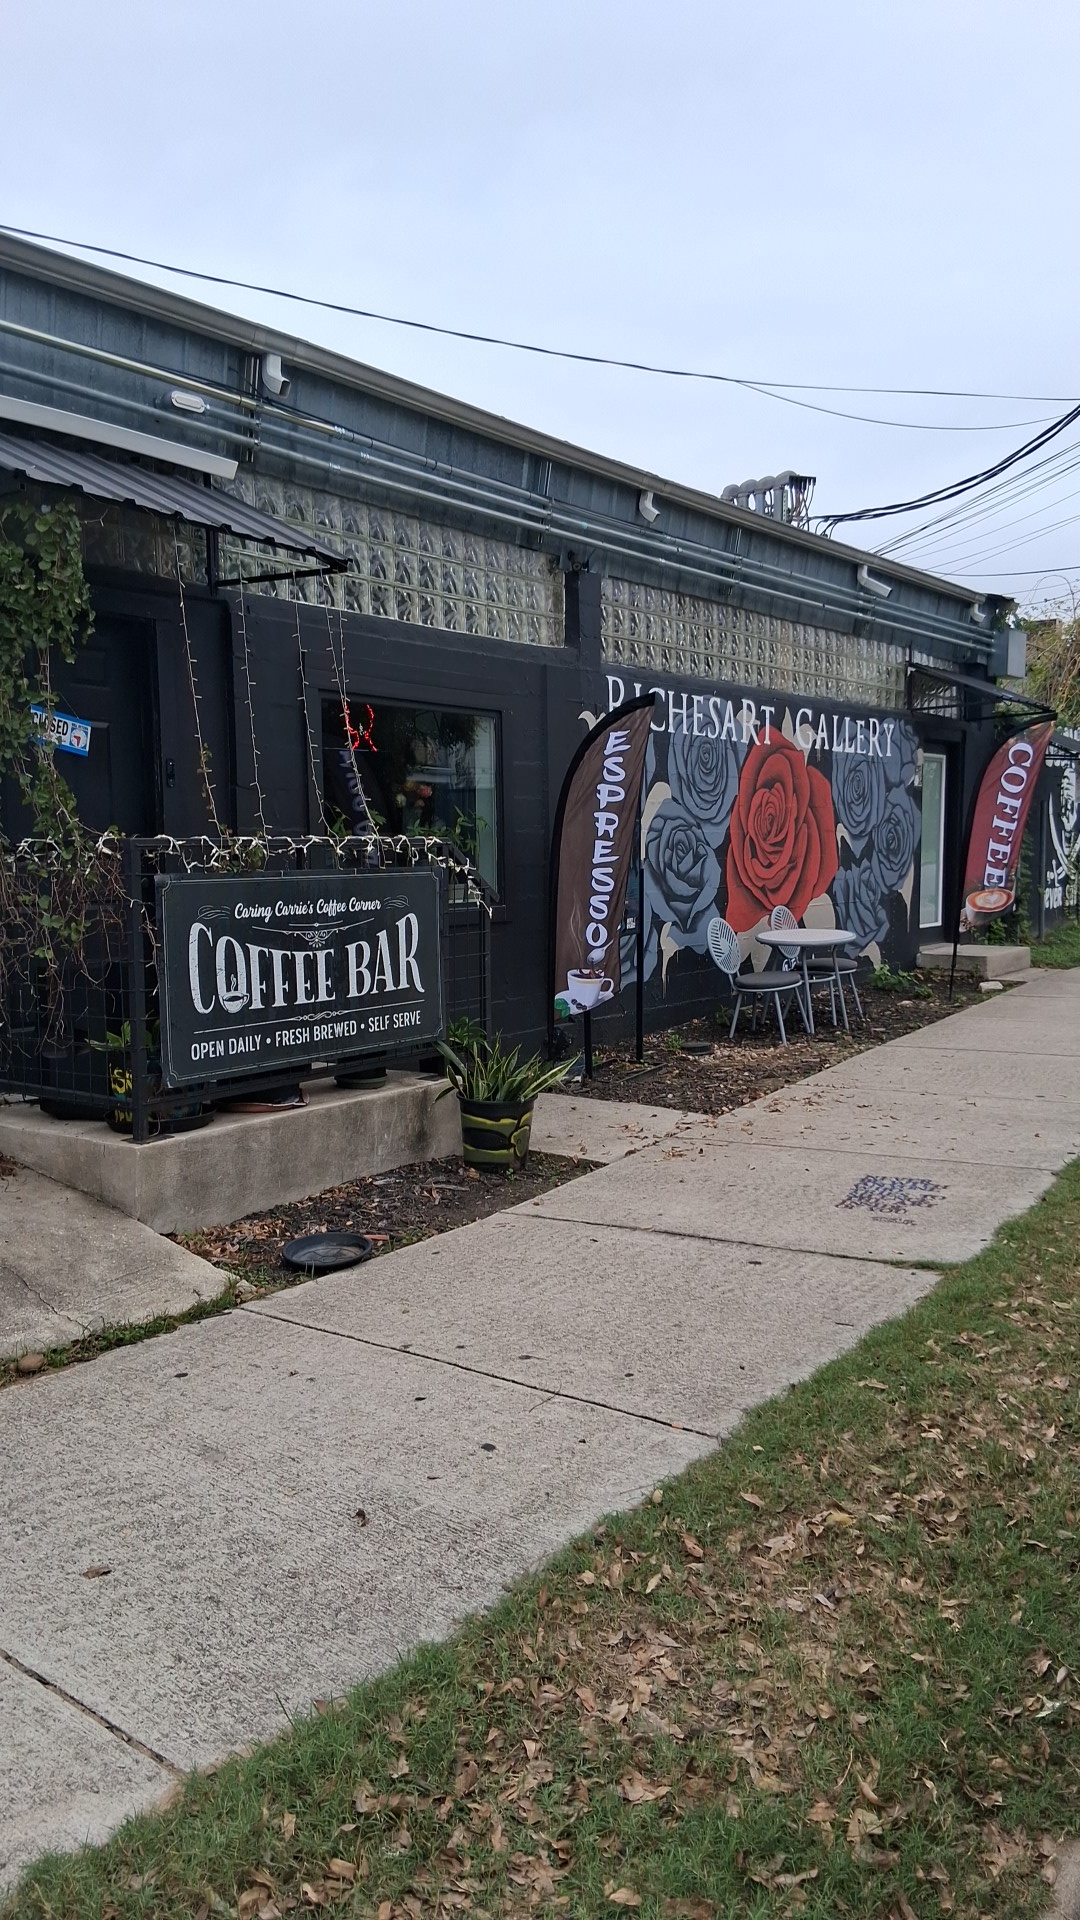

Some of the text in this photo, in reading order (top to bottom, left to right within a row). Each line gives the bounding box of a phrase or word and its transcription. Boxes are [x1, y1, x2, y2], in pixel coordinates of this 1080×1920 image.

[605, 675, 895, 757] RCHESART GALLERY
[585, 729, 631, 948] ESPRESSO
[984, 742, 1034, 888] COFFEE
[234, 897, 382, 923] Caring Carrie's Coffee Corner
[188, 912, 425, 1014] COFFEE BAR
[190, 1010, 421, 1061] OPEN DAILY FRESH BREWED SELF SERVE
